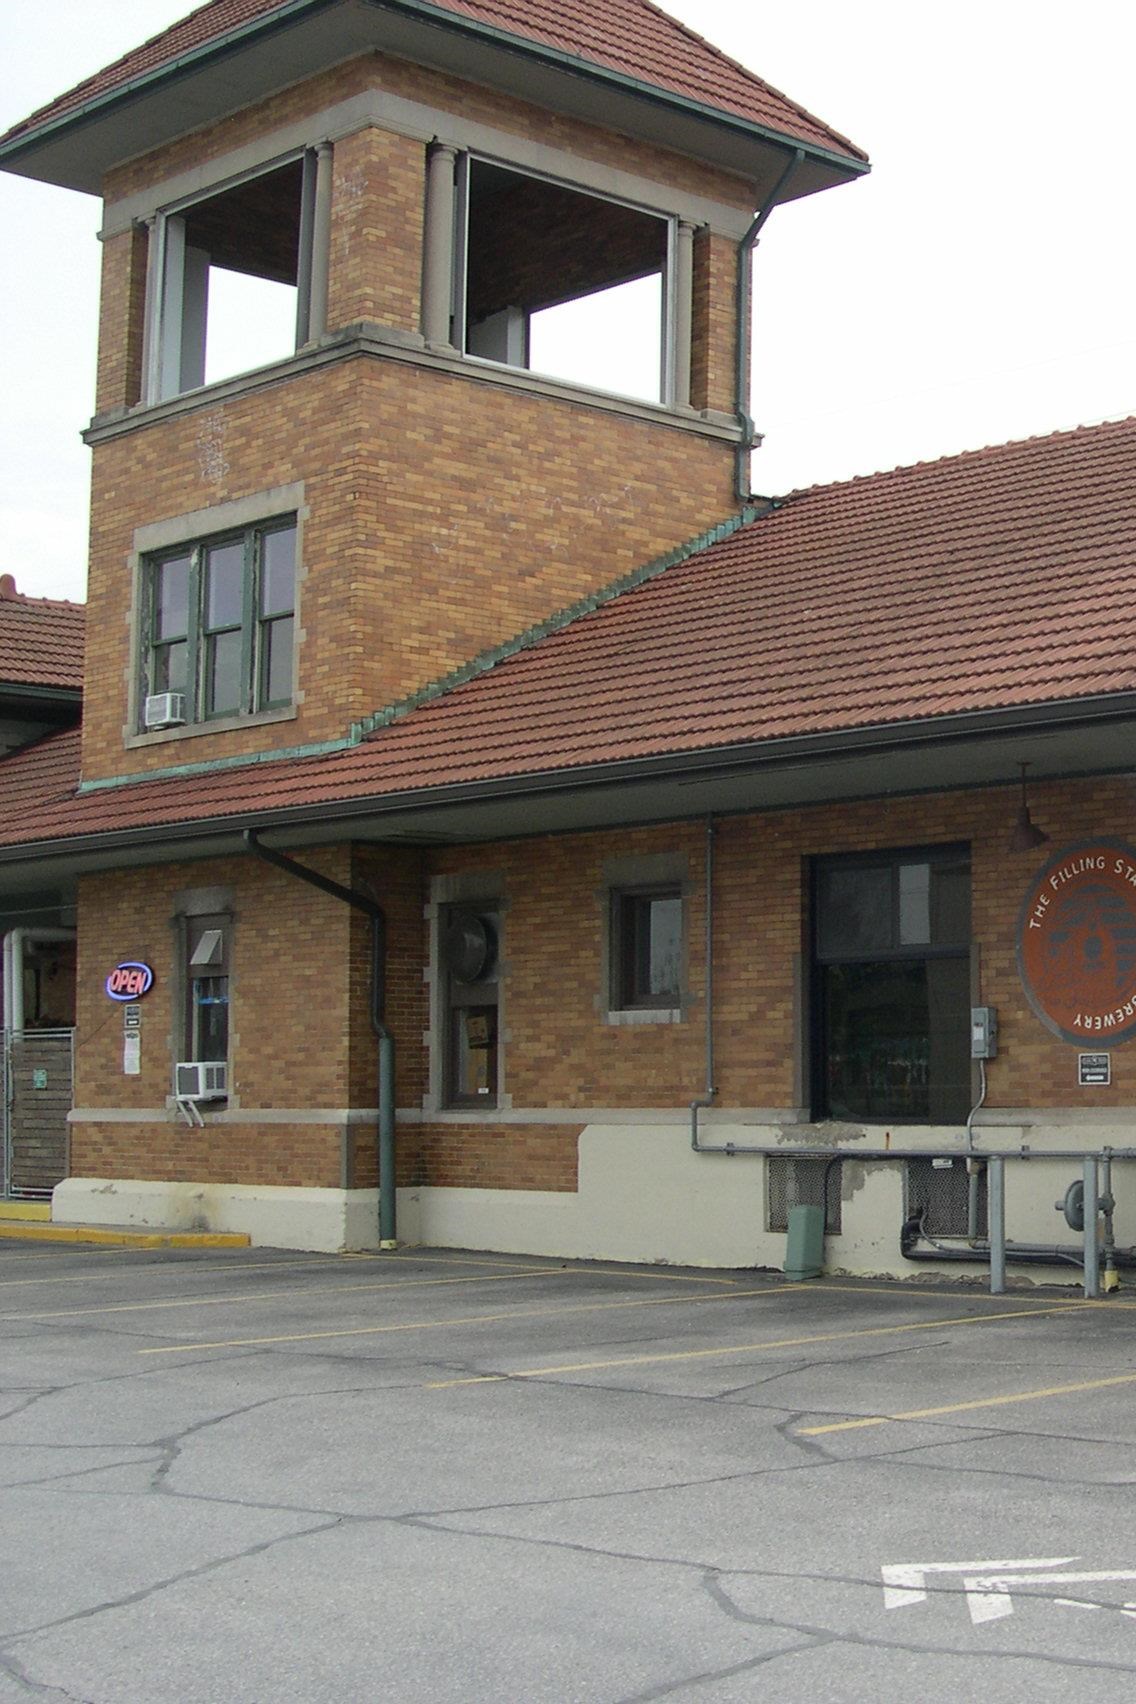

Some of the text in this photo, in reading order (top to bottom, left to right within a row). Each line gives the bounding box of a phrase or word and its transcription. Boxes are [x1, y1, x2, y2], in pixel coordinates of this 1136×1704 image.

[1028, 893, 1050, 929] THE
[1049, 855, 1105, 891] FILLING
[110, 969, 147, 994] OPEN
